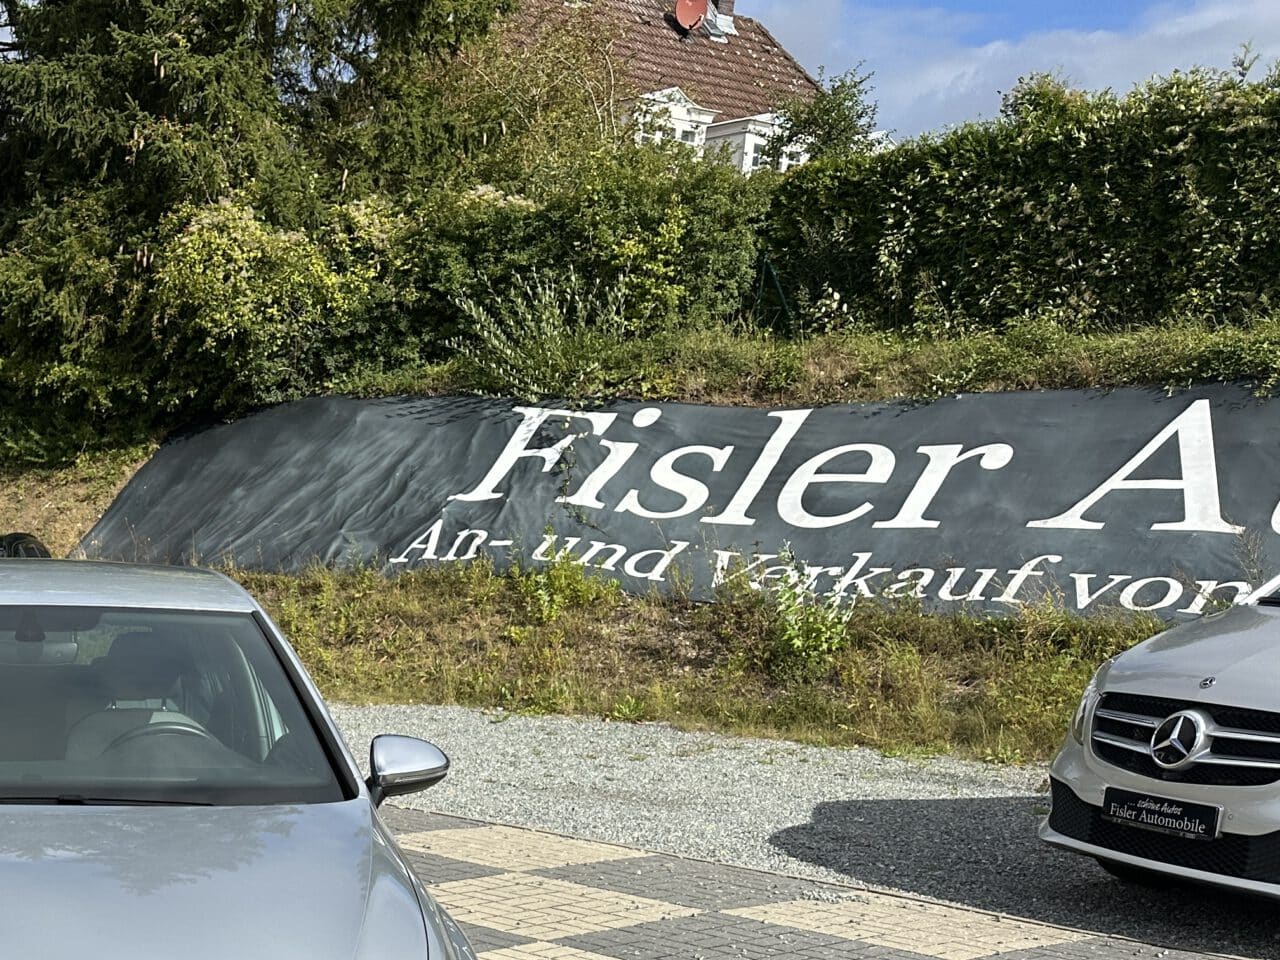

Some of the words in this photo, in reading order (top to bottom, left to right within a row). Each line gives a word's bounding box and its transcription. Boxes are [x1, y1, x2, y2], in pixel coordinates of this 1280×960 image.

[447, 406, 1014, 529] Fisler
[1025, 398, 1280, 535] A
[389, 519, 513, 563] An-
[531, 534, 690, 582] und
[1109, 802, 1137, 820] Fisler
[1138, 810, 1206, 834] Automobile
[1160, 802, 1183, 815] Autos
